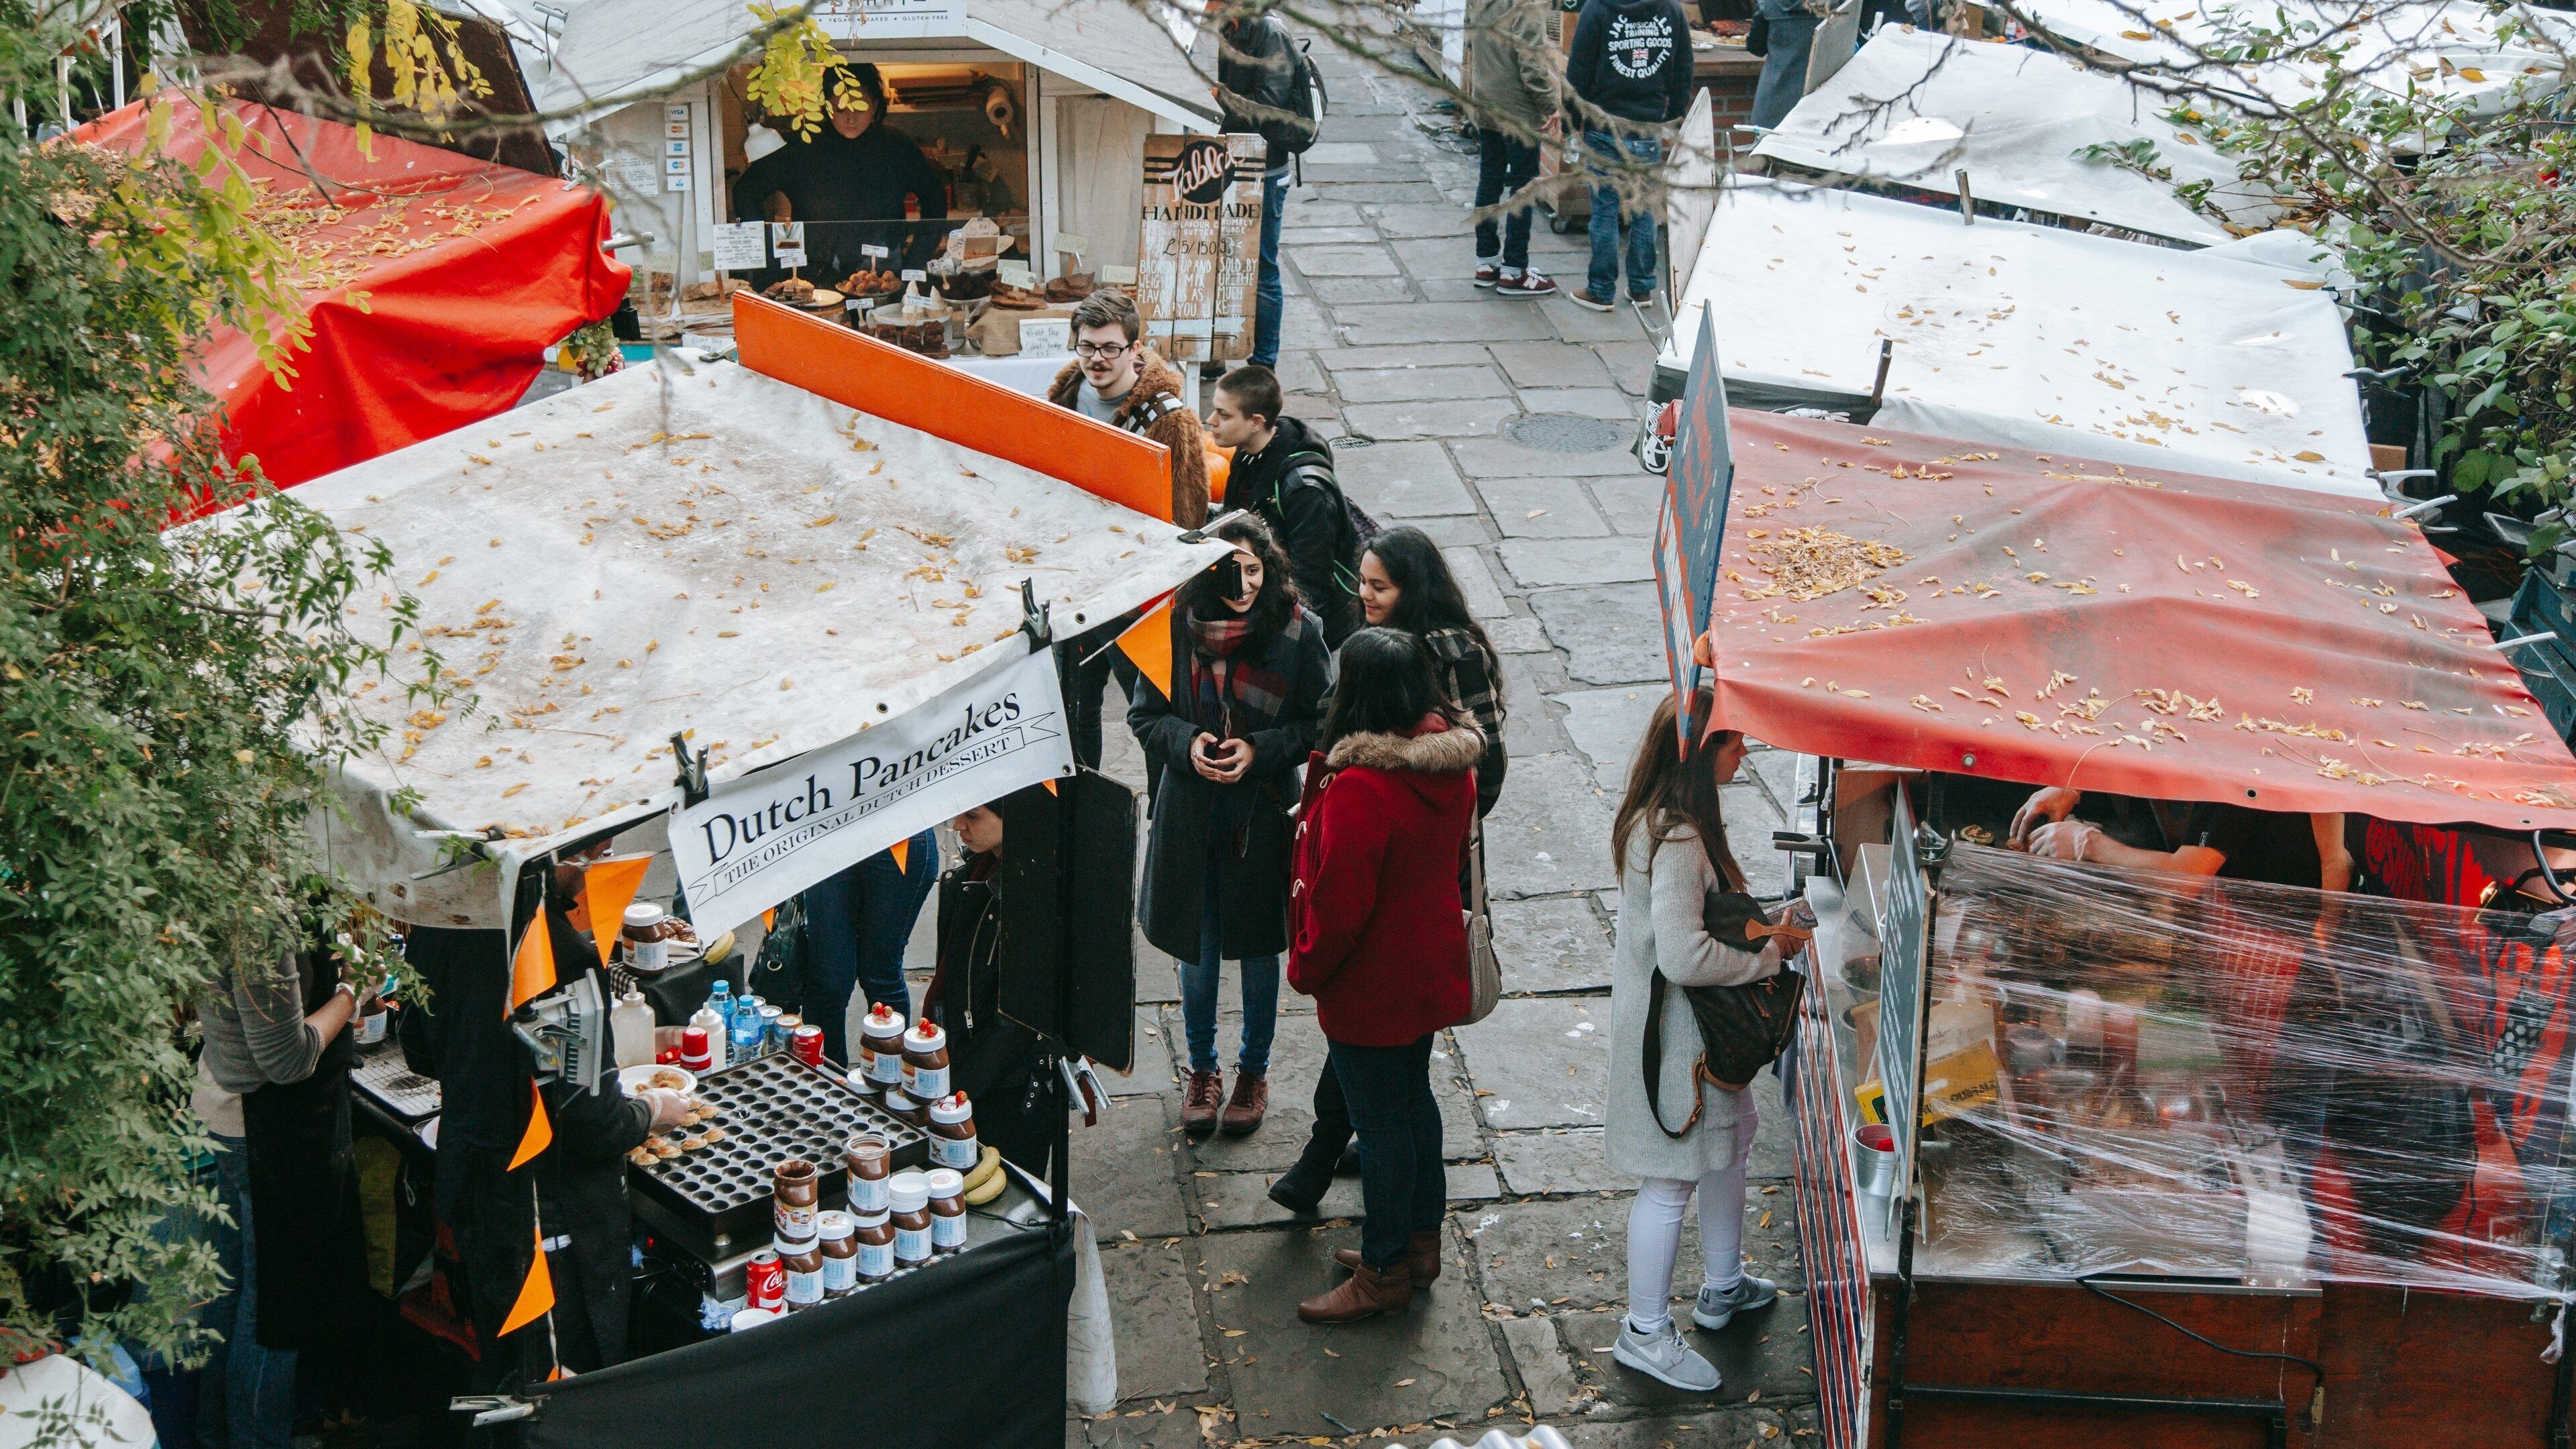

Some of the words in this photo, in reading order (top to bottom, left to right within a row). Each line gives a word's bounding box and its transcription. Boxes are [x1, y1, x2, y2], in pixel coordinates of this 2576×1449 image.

[1624, 29, 1659, 38] TRAINING
[1608, 38, 1645, 52] SPORTING
[1646, 38, 1672, 48] GOODS
[1609, 54, 1636, 78] FINEST
[1636, 48, 1670, 78] QUALITY
[1142, 203, 1260, 221] HANDMADE
[1219, 256, 1242, 272] SOLD
[1246, 258, 1258, 273] BY
[1192, 287, 1203, 301] AS
[1177, 302, 1197, 317] YOU
[700, 773, 833, 866] Dutch
[849, 692, 1022, 801] Pancakes
[724, 855, 759, 885] THE
[763, 811, 855, 862] ORIGINAL
[857, 776, 921, 817] DUTCH
[926, 736, 1012, 782] DESSERT
